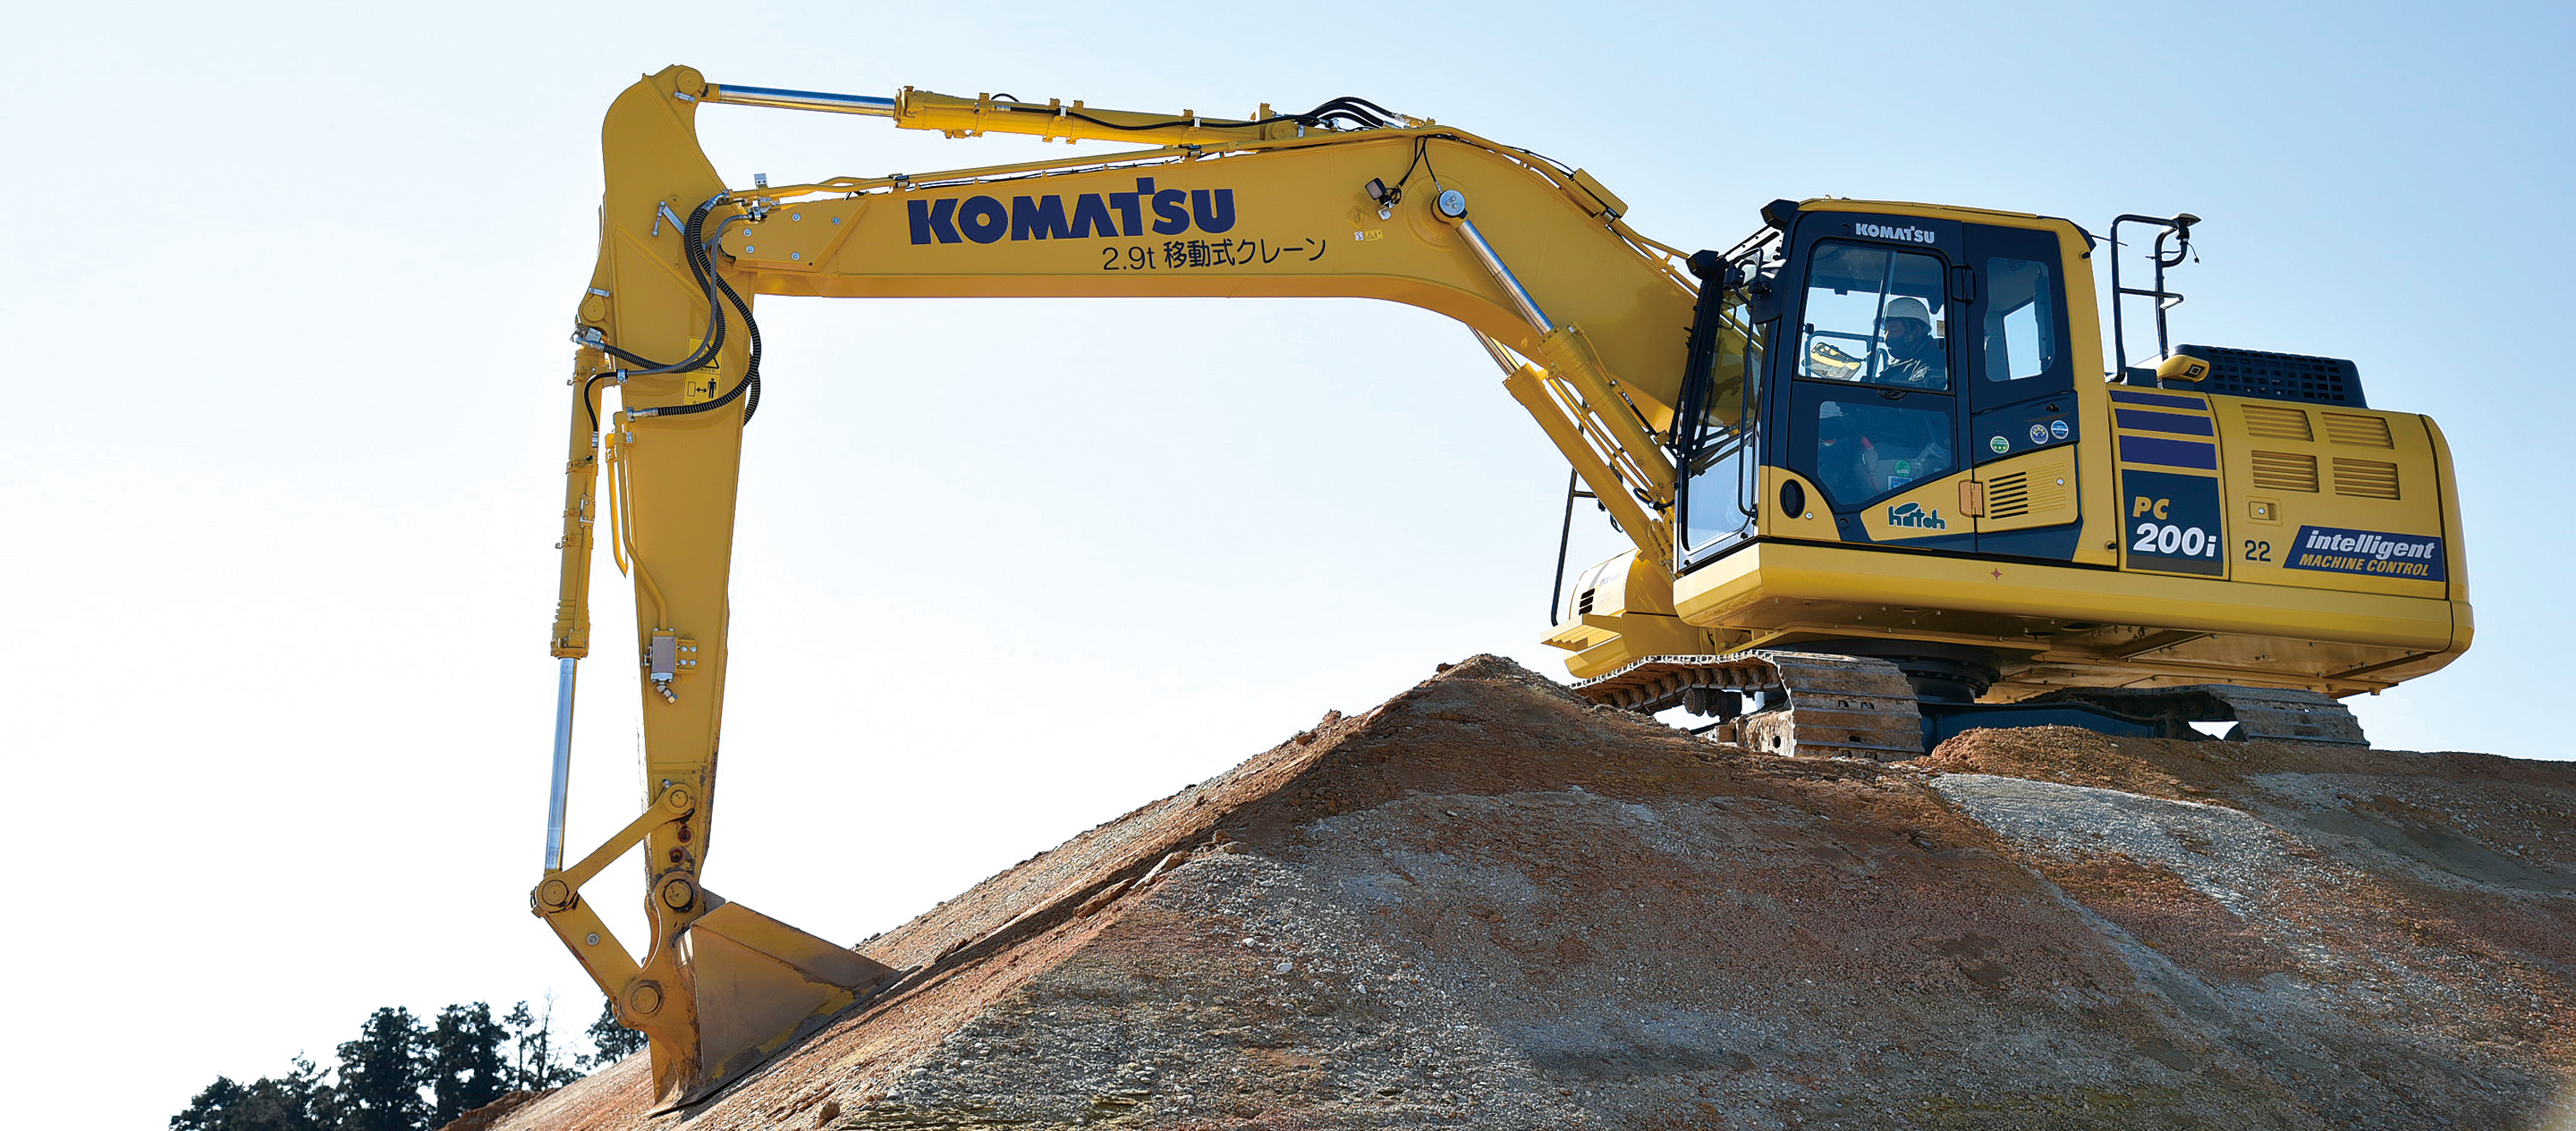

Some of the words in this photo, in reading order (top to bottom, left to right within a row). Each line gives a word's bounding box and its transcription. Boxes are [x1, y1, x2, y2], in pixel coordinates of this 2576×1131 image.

[907, 177, 1236, 245] KOMATSU
[1855, 223, 1936, 244] KOMATSU
[1102, 246, 1157, 271] 2.9t
[1163, 238, 1326, 269] 移動式クレーン
[2132, 495, 2170, 520] PC
[2132, 522, 2217, 558] 200i
[2244, 539, 2271, 562] 22
[2306, 530, 2435, 560] intelligent
[2299, 553, 2366, 570] MACHINE
[2366, 559, 2429, 577] CONTROL
